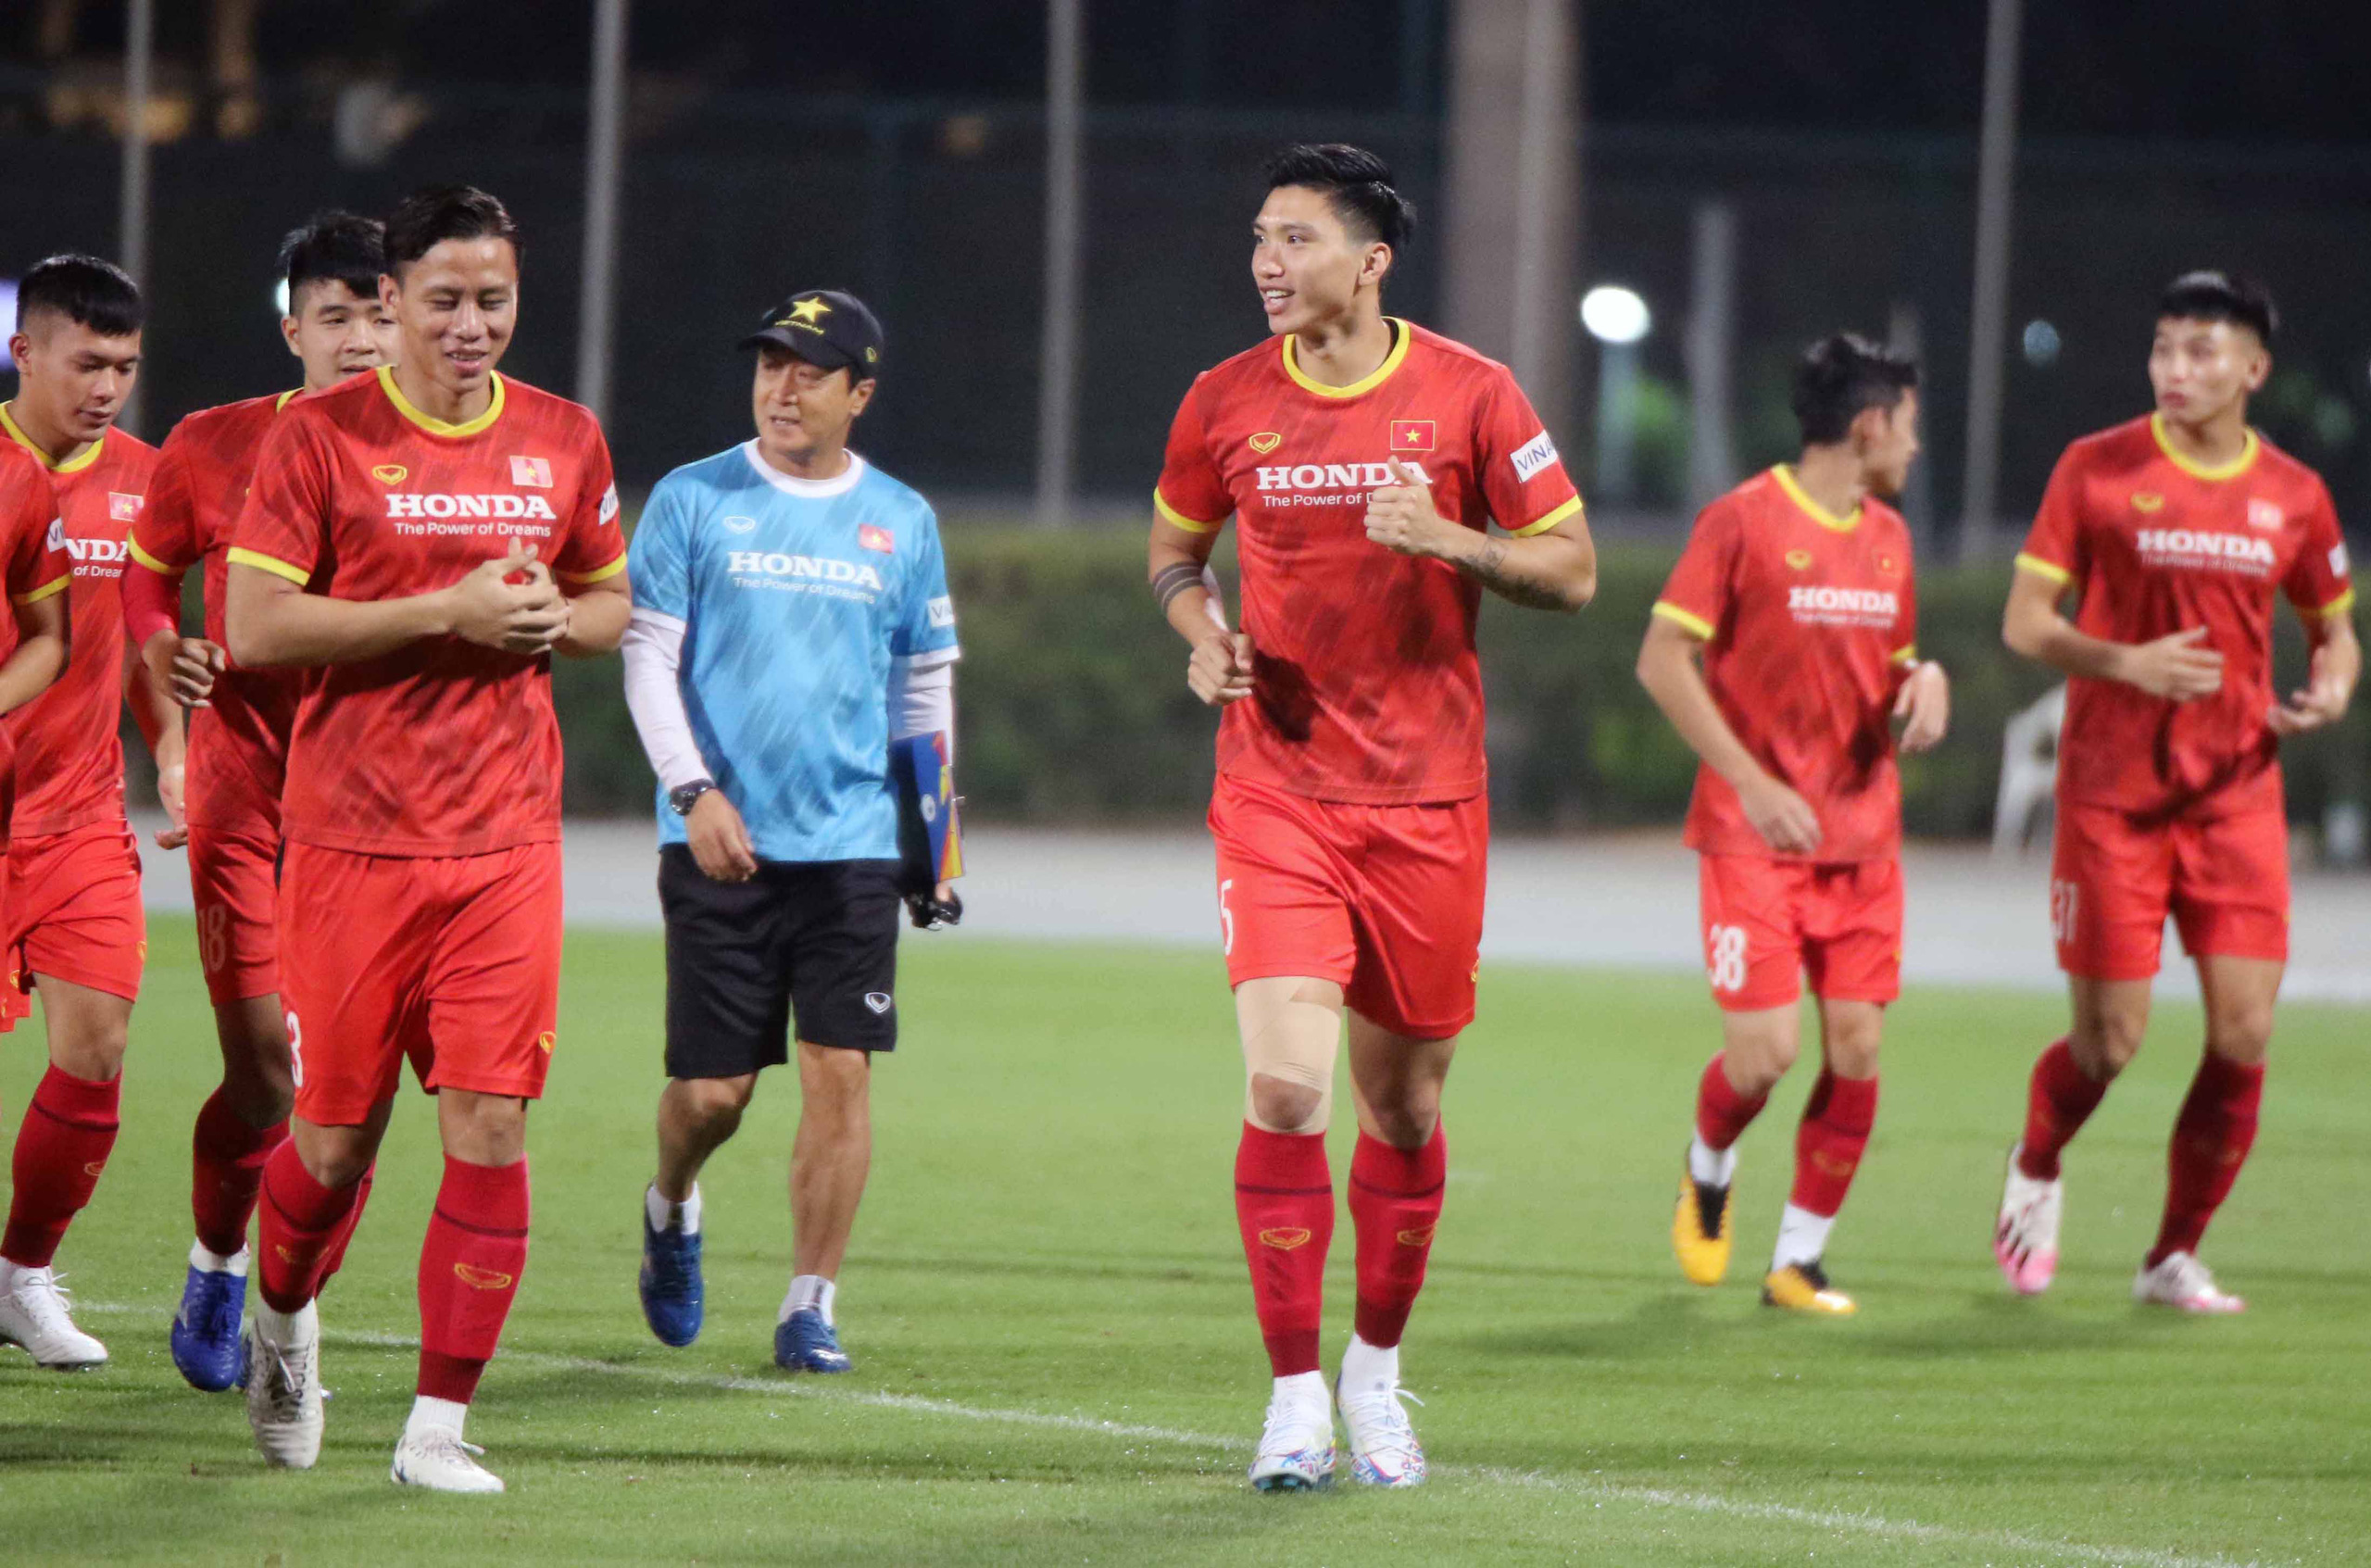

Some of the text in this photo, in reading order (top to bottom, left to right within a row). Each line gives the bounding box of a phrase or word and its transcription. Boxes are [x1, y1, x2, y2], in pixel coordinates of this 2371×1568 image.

[385, 494, 557, 520] HONDA
[1262, 495, 1291, 507] The
[1293, 494, 1343, 507] Power
[1346, 492, 1362, 505] of
[395, 522, 551, 537] The Power of Dreams
[2137, 529, 2276, 565] HONDA
[73, 565, 89, 577] of
[727, 551, 883, 590] HONDA
[734, 577, 875, 605] The Power of Dreams
[1788, 586, 1898, 614] HONDA
[1708, 923, 1747, 991] 38
